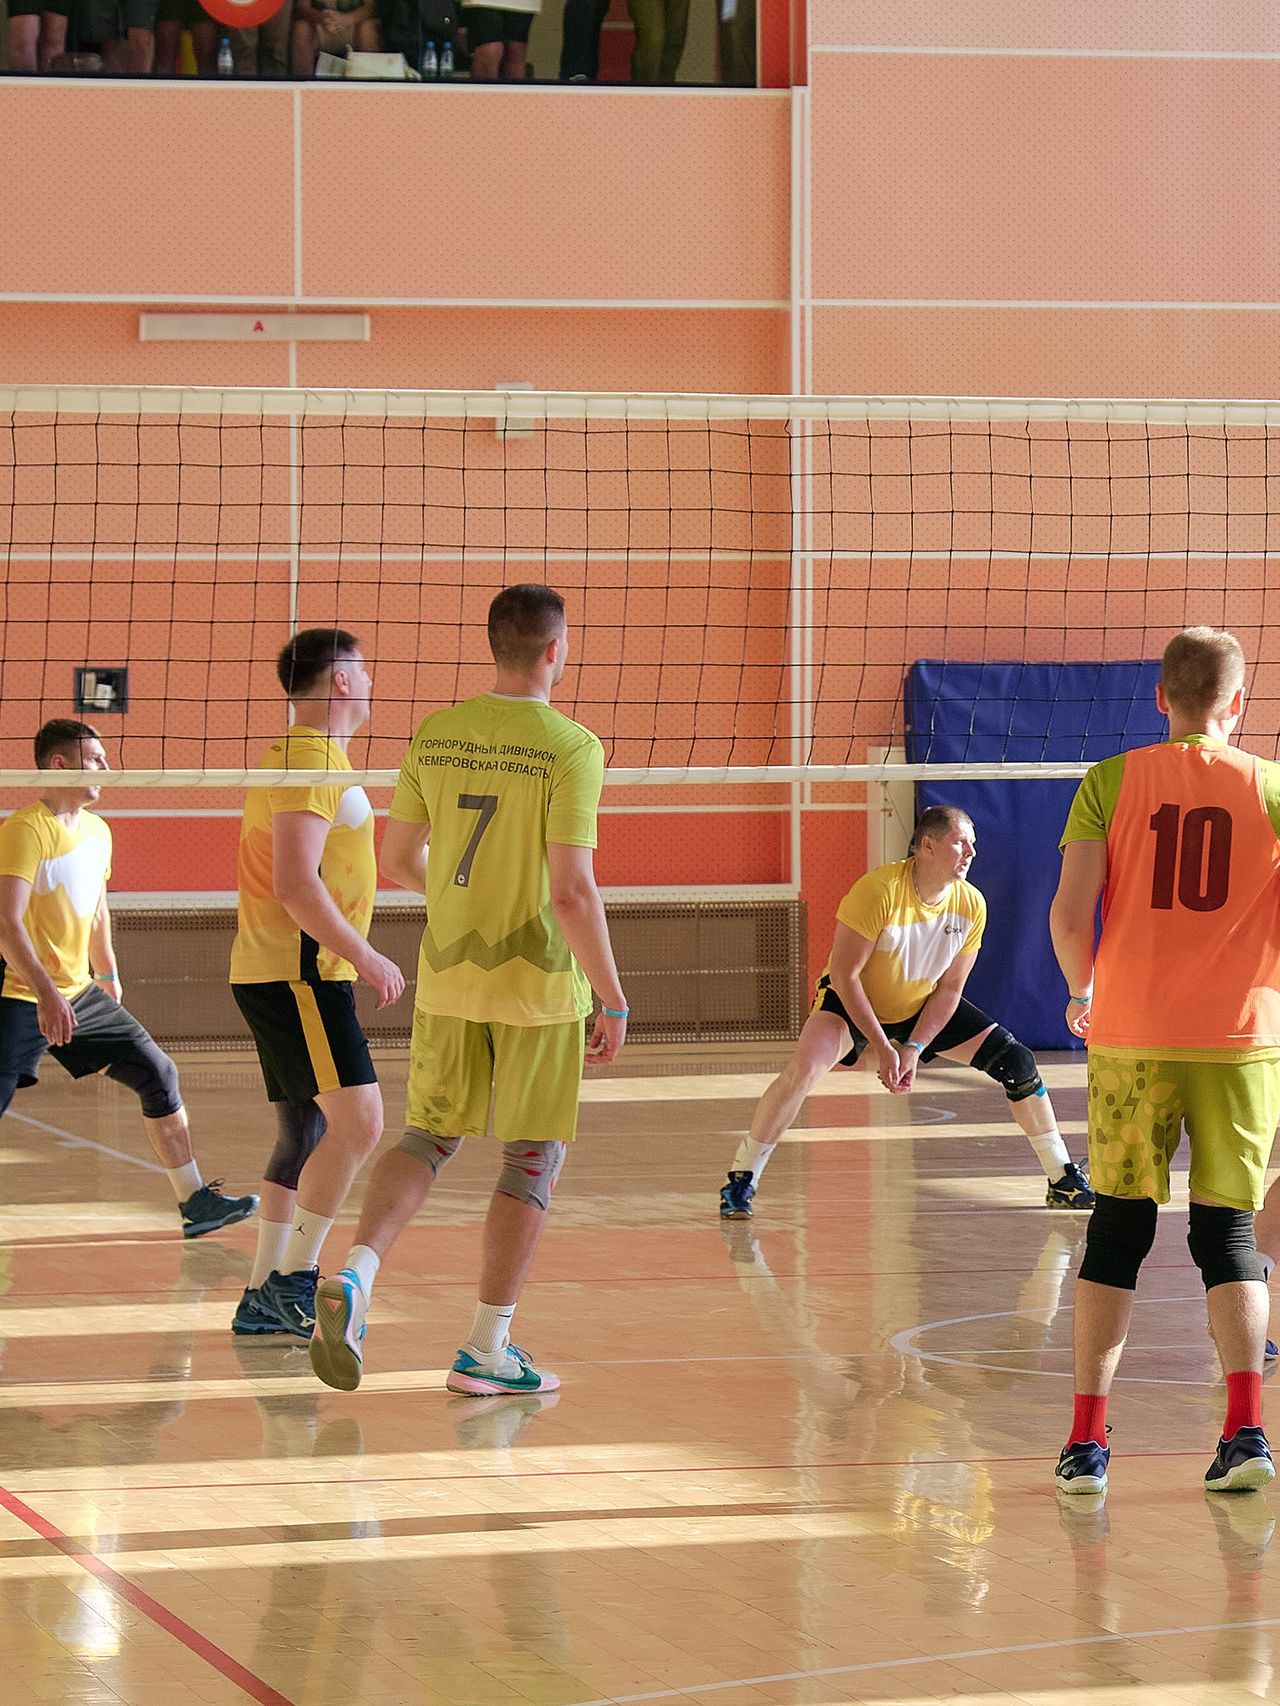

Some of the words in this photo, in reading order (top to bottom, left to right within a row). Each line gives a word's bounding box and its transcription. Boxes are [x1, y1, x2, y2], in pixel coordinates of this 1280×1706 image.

[418, 755, 498, 771] КЕМЕРОВСКАЯ
[499, 760, 550, 780] ОБЛАСТЬ
[420, 739, 497, 755] ГОРНОРУДНЫЙ
[499, 743, 557, 764] ДИВИЗИОН
[453, 793, 499, 888] 7
[1149, 803, 1233, 913] 10
